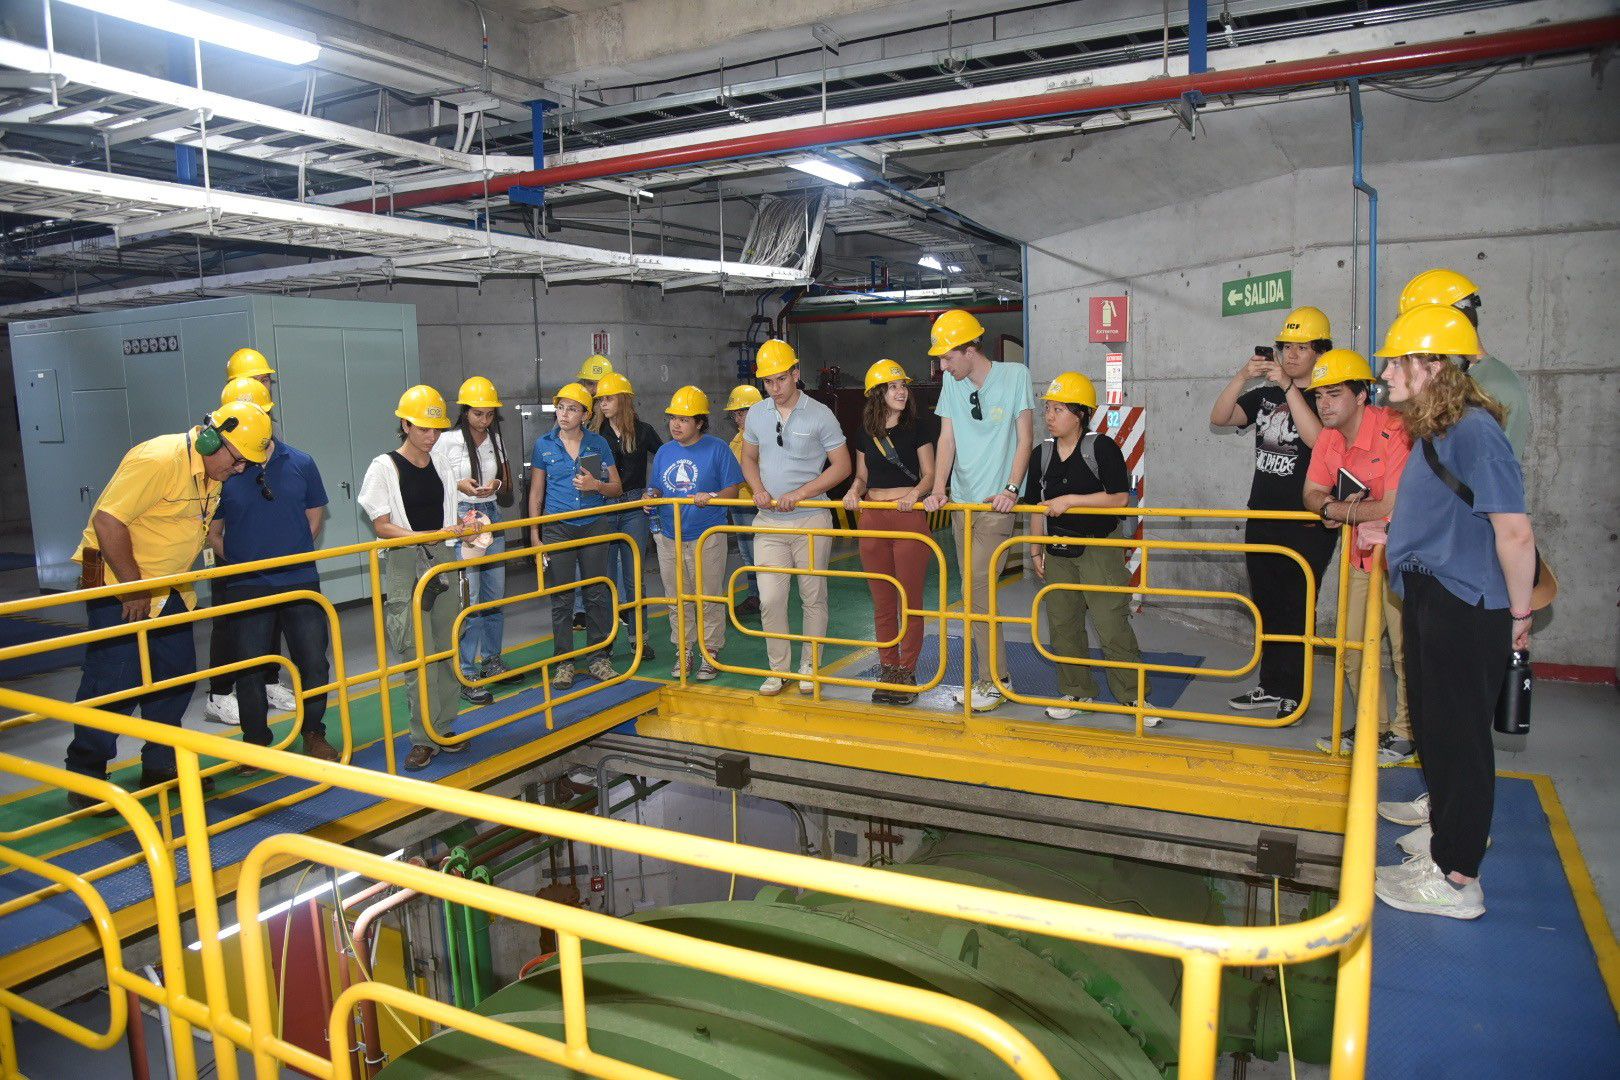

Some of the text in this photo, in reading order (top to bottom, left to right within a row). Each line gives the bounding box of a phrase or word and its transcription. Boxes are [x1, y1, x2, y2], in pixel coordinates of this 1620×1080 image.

[1244, 278, 1284, 306] SALIDA
[660, 364, 669, 382] 3
[1107, 411, 1120, 427] 32
